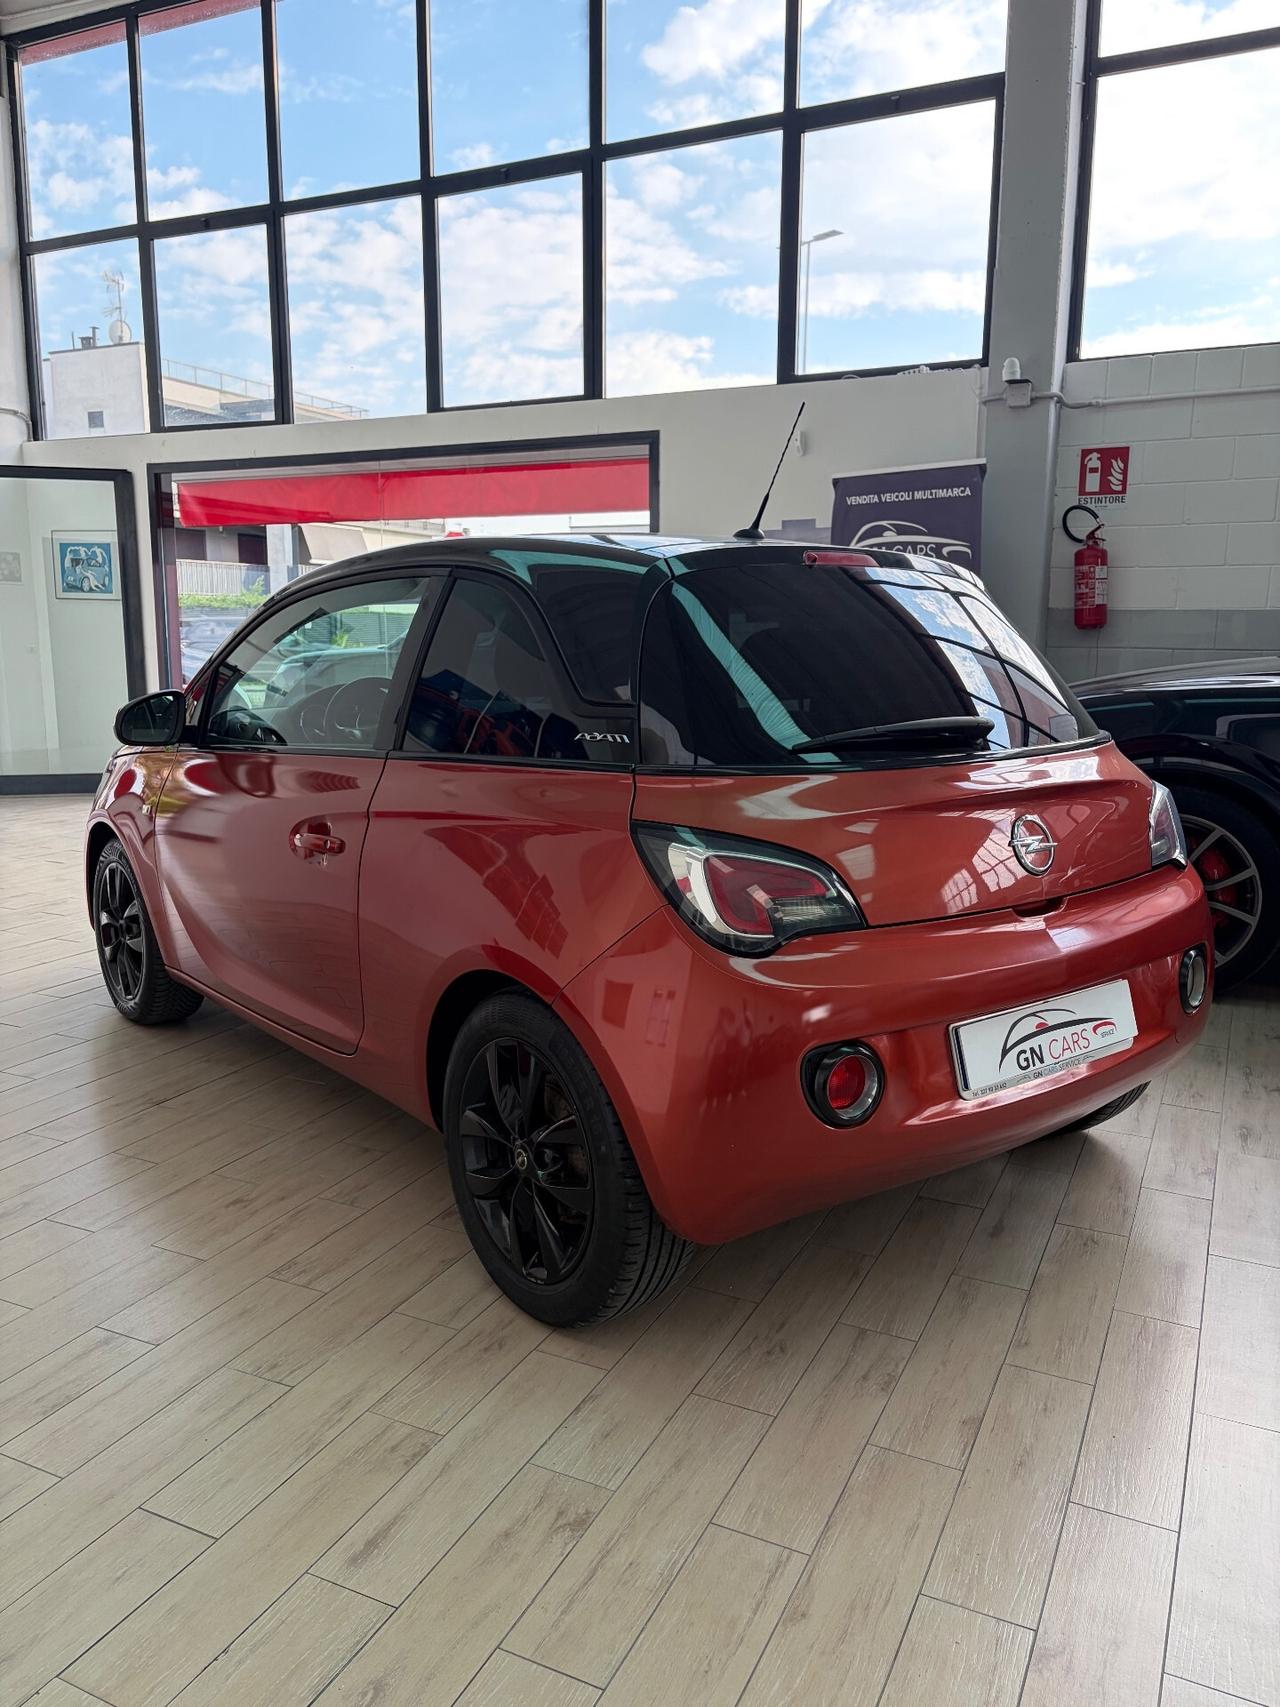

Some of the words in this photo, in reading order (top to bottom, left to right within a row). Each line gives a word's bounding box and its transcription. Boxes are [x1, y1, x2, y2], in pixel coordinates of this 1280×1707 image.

[846, 494, 879, 505] VENDITA
[880, 491, 912, 502] VEICOLI
[914, 487, 971, 500] MULTIMARCA
[1078, 496, 1126, 505] ESTINTORE
[1016, 1044, 1045, 1070] GN
[1049, 1029, 1090, 1059] CARS
